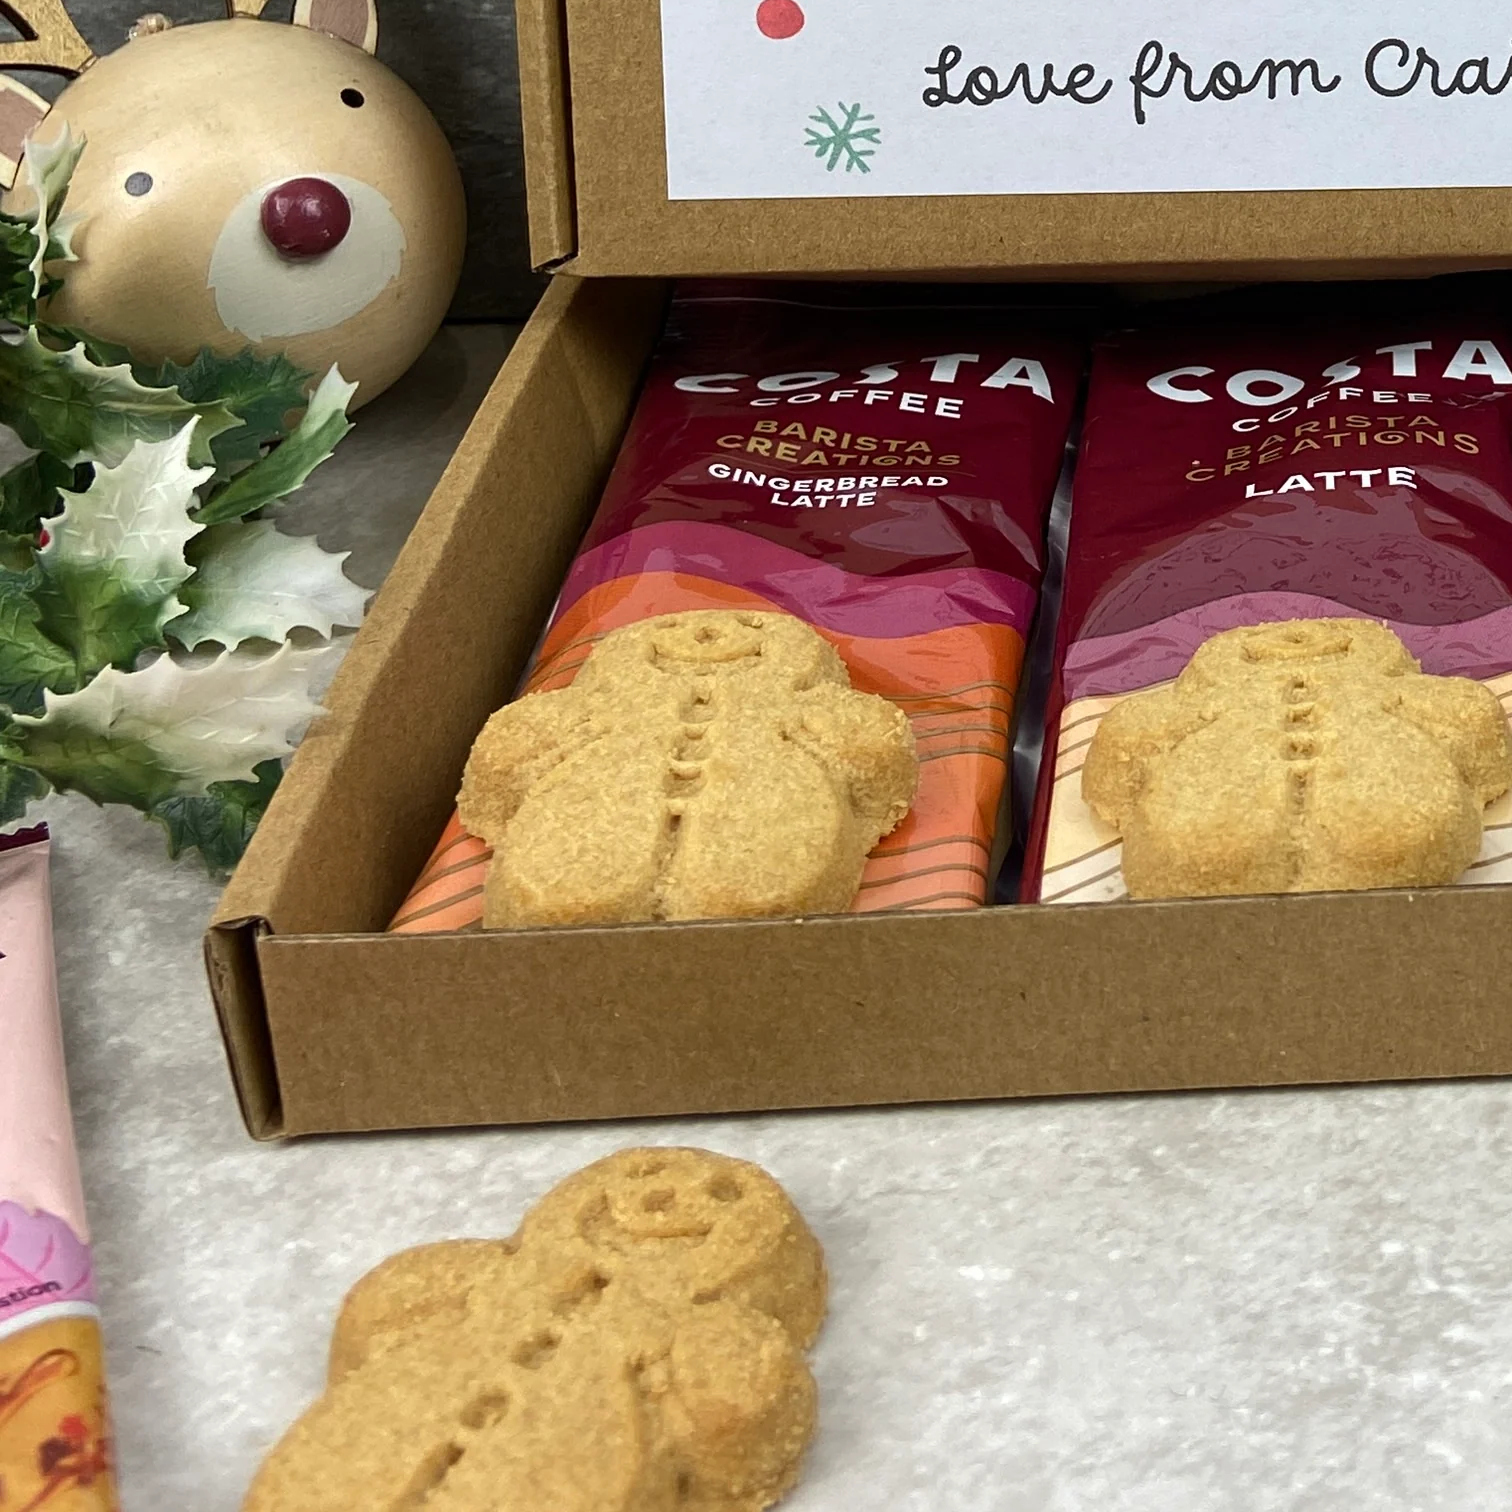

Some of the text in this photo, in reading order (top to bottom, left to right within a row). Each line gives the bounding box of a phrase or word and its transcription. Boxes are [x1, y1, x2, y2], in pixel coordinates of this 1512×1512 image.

[921, 43, 1114, 108] Love
[1127, 39, 1342, 125] from
[675, 352, 1055, 404] COSTA
[749, 389, 964, 419] COFFEE
[1231, 386, 1434, 433] COFFEE
[715, 434, 961, 467] CREATIONS
[752, 420, 932, 454] BARISTA
[1226, 414, 1440, 461] BARISTA
[1185, 430, 1480, 483] CREATIONS
[707, 462, 949, 494] GINGERBREAD
[1244, 465, 1418, 499] LATTE
[770, 491, 877, 508] LATTE
